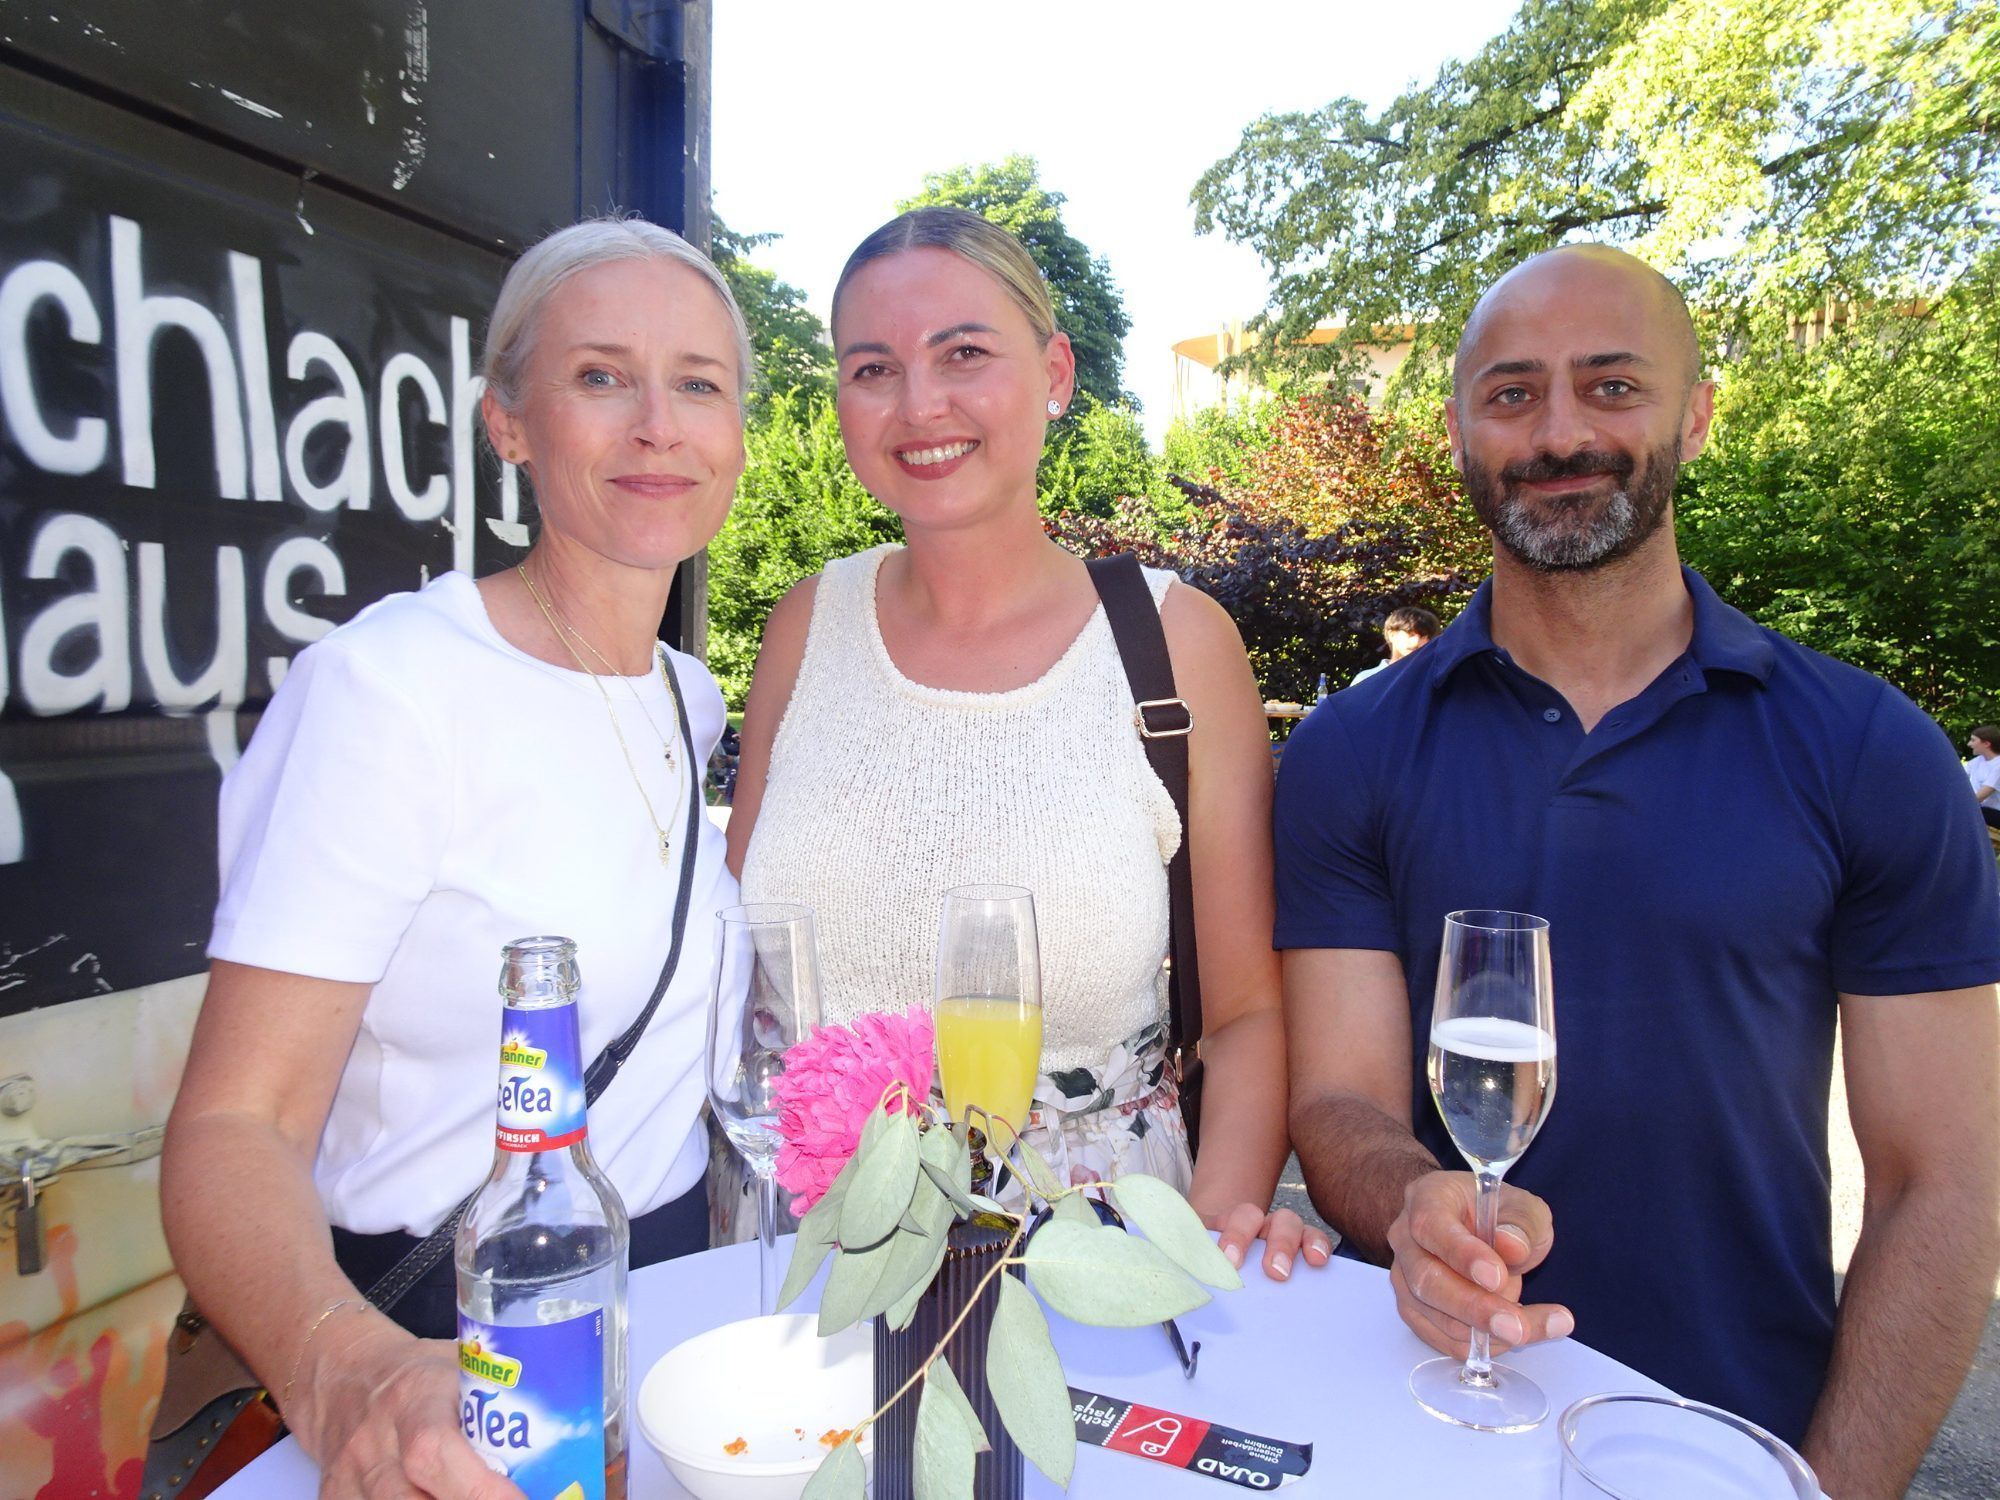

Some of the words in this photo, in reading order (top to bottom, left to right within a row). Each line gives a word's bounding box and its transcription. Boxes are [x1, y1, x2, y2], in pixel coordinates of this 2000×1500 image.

[459, 1389, 532, 1449] eTea
[1244, 1438, 1284, 1454] Dornbirn
[1249, 1451, 1280, 1464] Offene
[1197, 1457, 1270, 1488] OJAD
